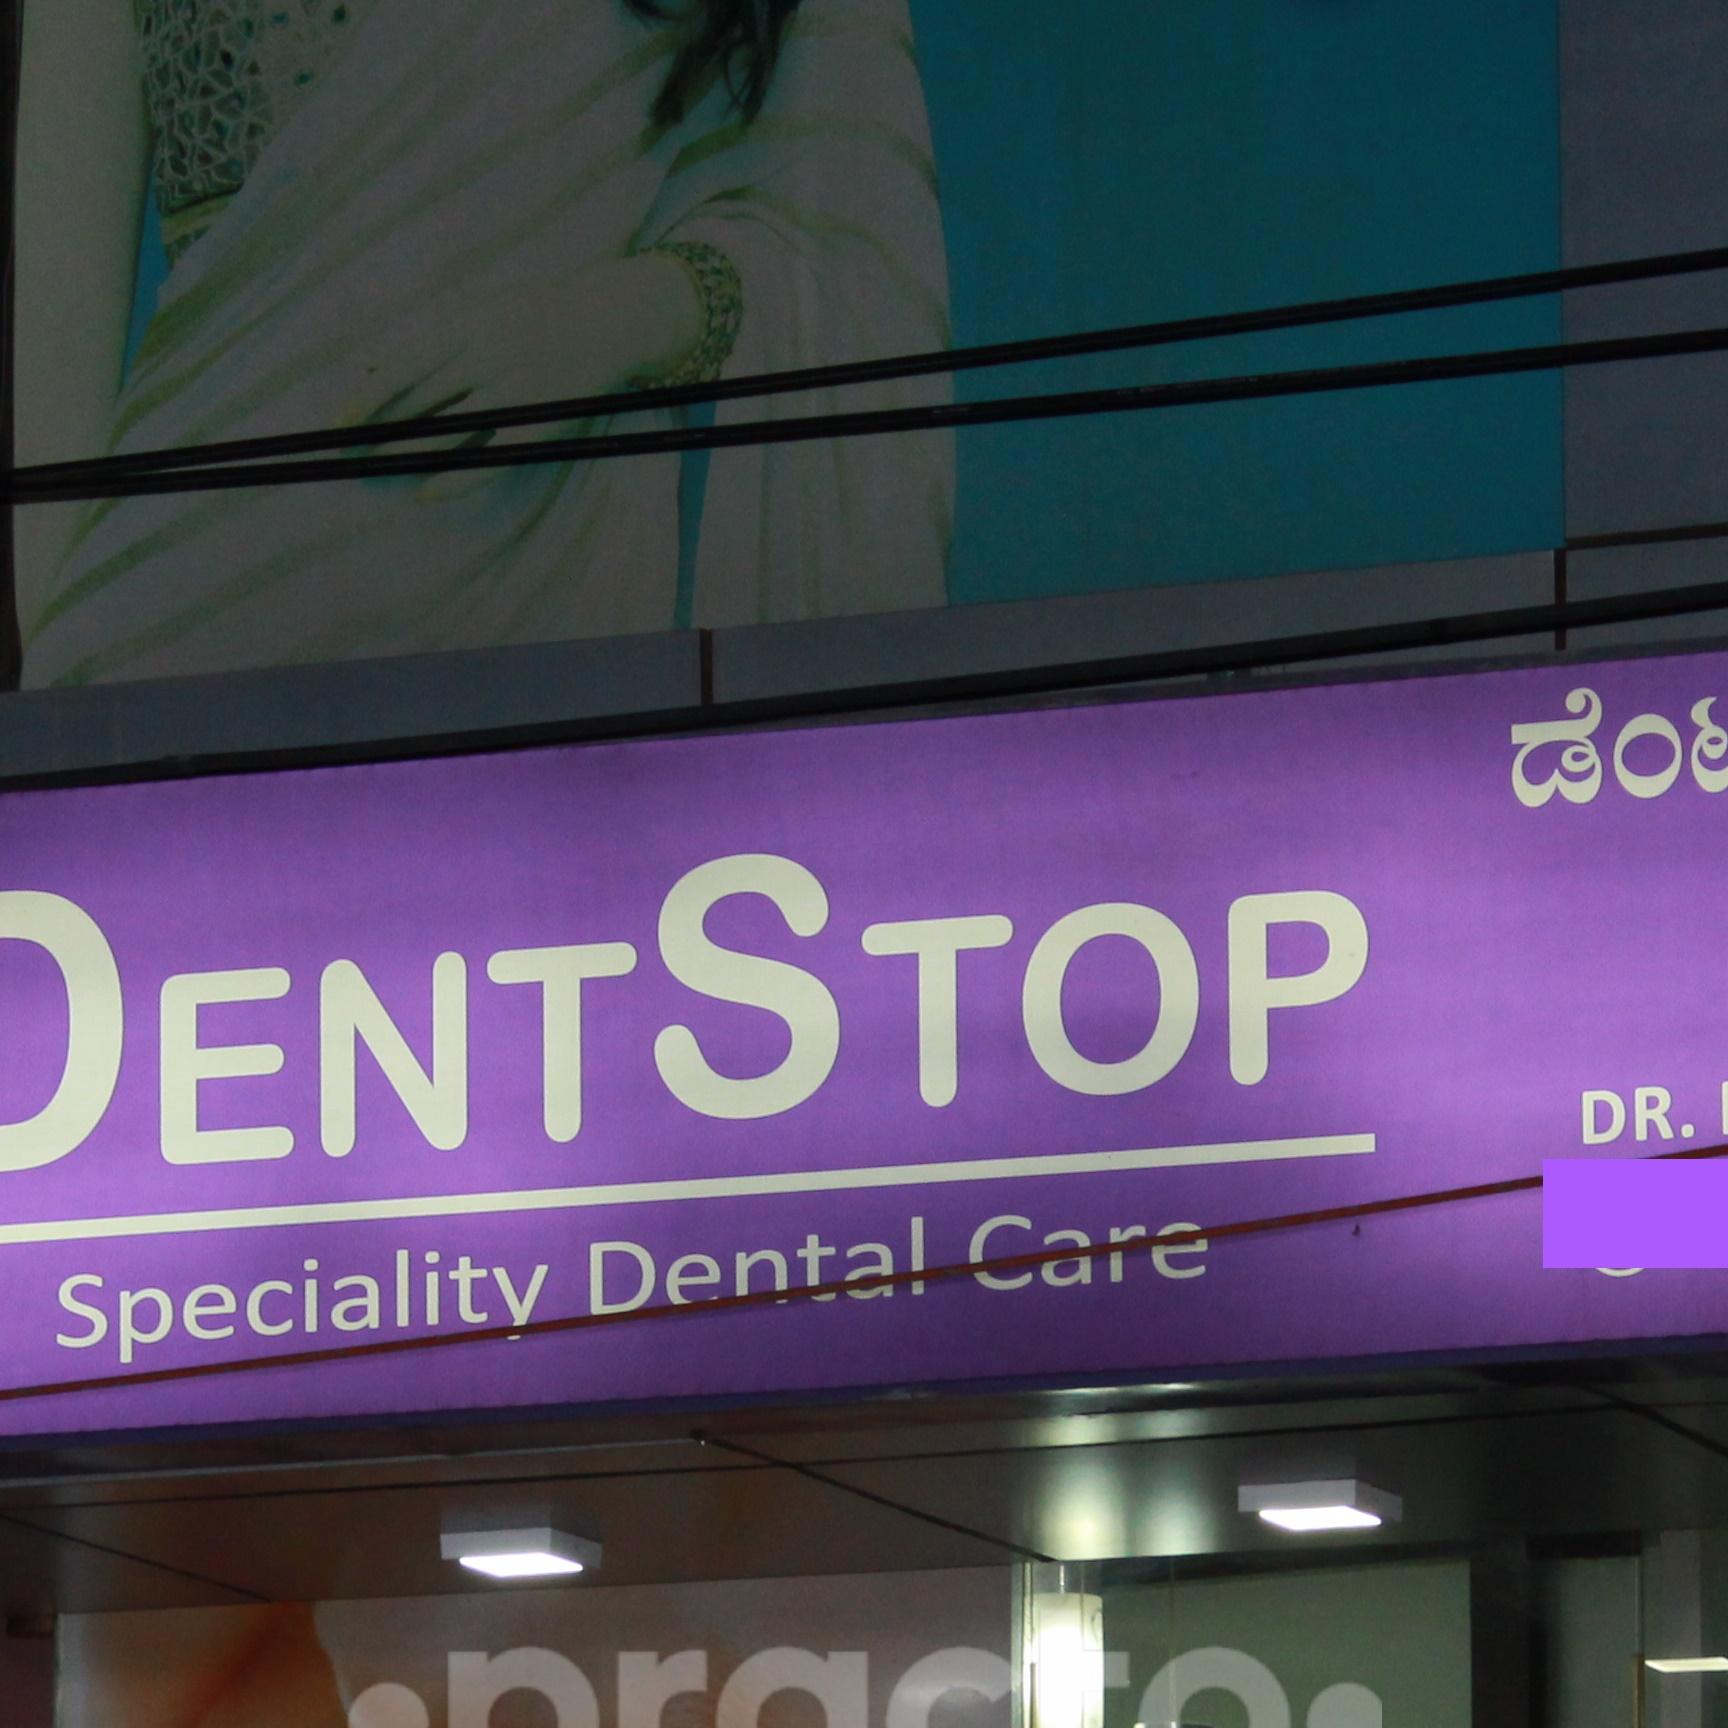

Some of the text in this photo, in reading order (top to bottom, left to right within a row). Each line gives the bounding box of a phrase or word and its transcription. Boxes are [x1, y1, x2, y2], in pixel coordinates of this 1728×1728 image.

[1581, 1084, 1696, 1147] DR.
[56, 1212, 1211, 1365] Speciality Dental Care
